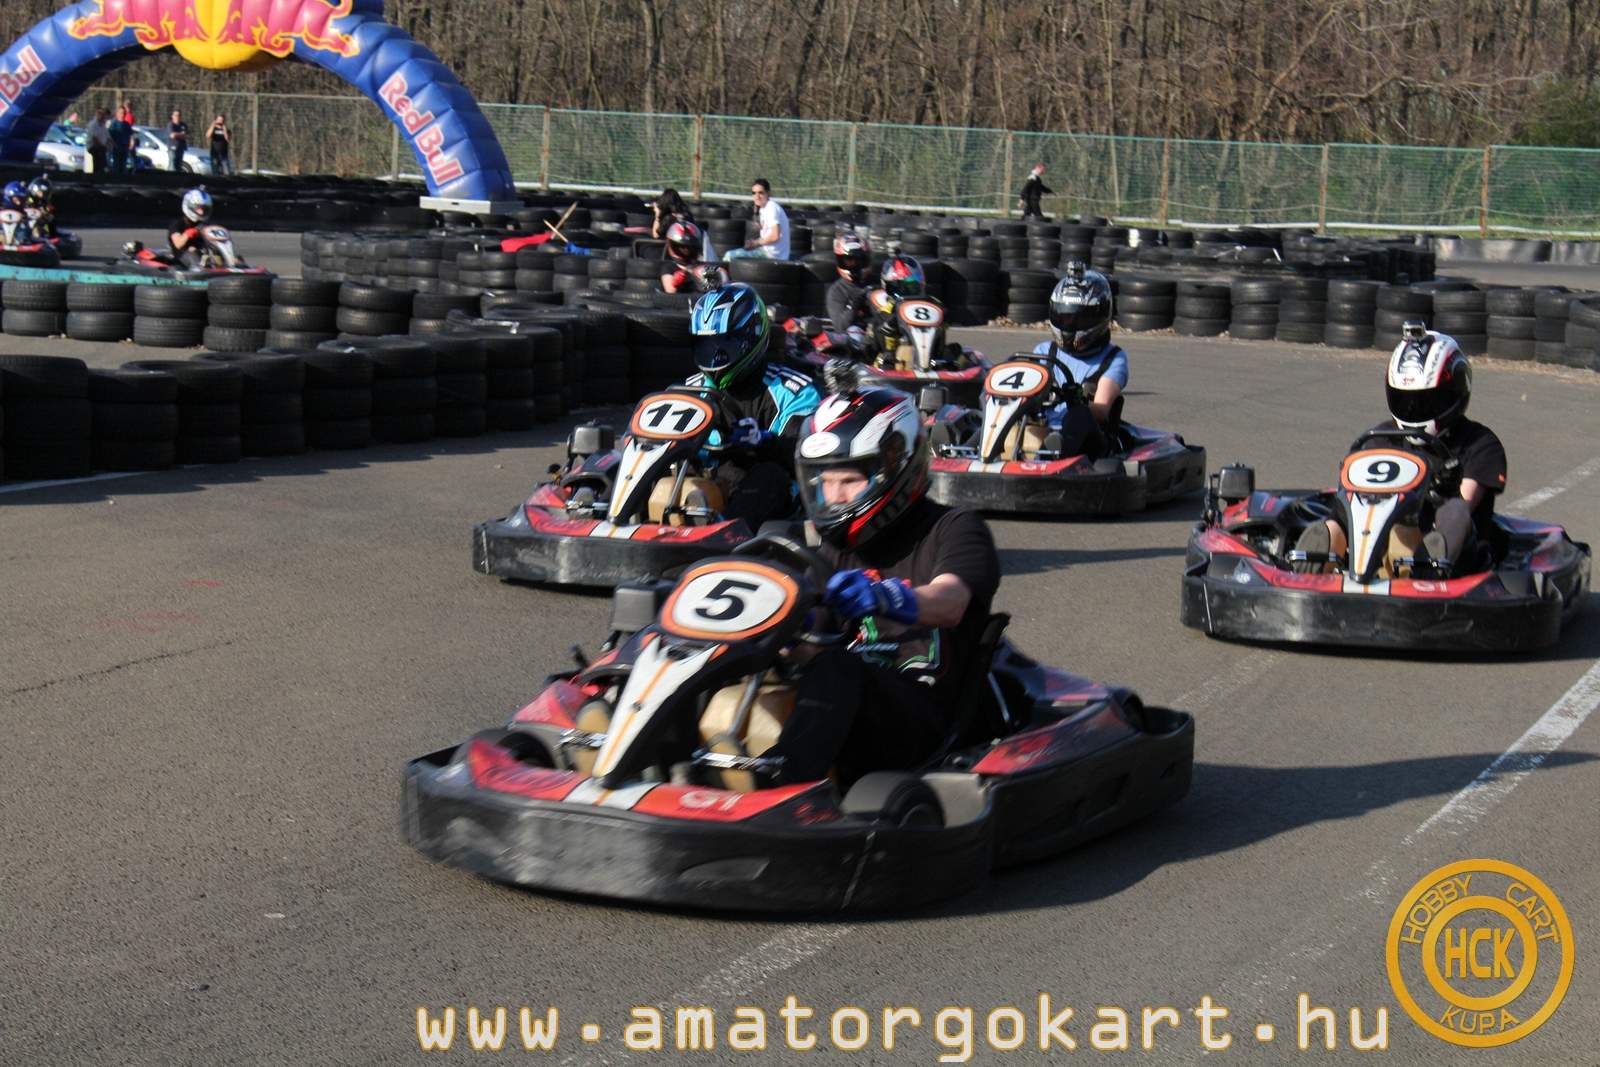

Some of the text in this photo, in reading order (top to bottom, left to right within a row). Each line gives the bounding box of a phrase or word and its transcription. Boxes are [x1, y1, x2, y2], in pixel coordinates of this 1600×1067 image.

[378, 71, 465, 186] Red Bull
[914, 307, 930, 320] 8
[998, 371, 1025, 389] 4
[647, 403, 698, 433] 11
[1366, 460, 1400, 483] 9
[695, 578, 760, 620] 5
